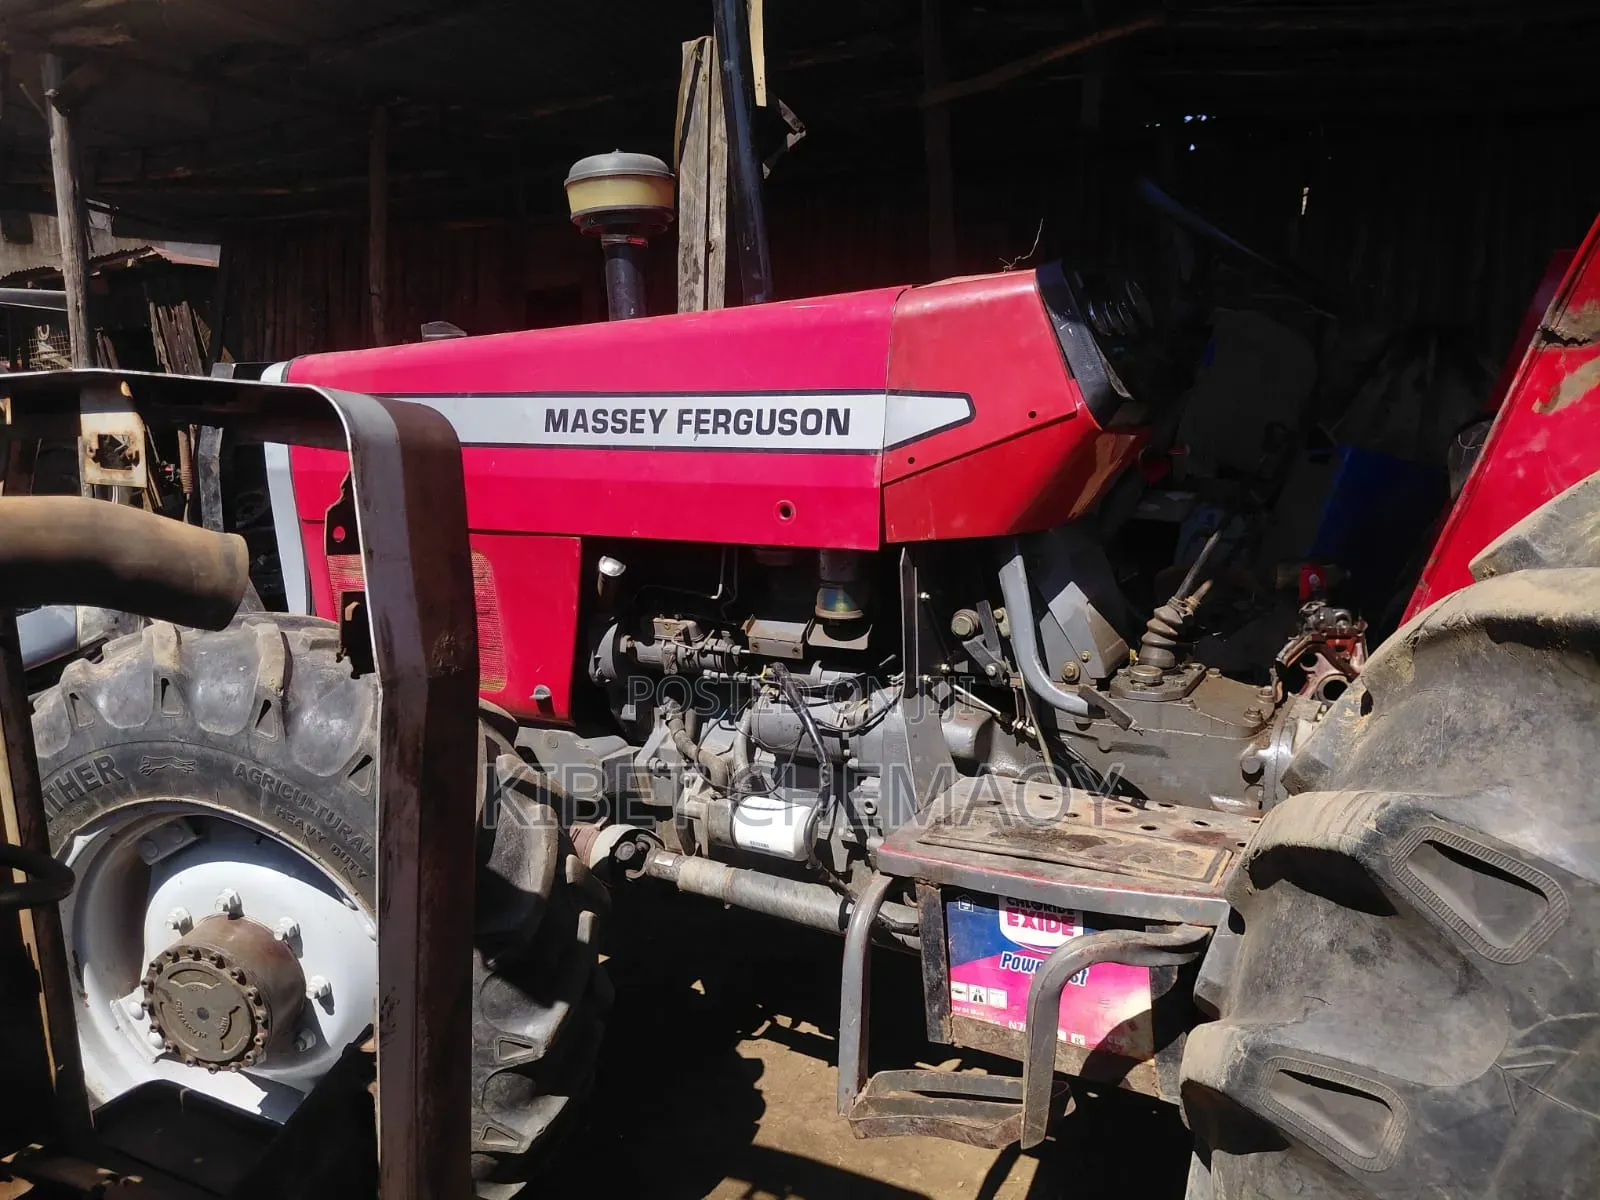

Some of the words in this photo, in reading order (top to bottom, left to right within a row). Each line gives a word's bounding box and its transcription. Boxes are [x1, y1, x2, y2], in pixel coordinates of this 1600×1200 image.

[544, 408, 668, 434] MASSEY
[676, 407, 851, 436] FERGUSON
[42, 755, 124, 823] THER
[233, 761, 374, 862] AGRICULTURAL
[274, 803, 328, 844] HEAVY
[330, 842, 369, 880] DUTY
[1005, 906, 1075, 937] EXIDE
